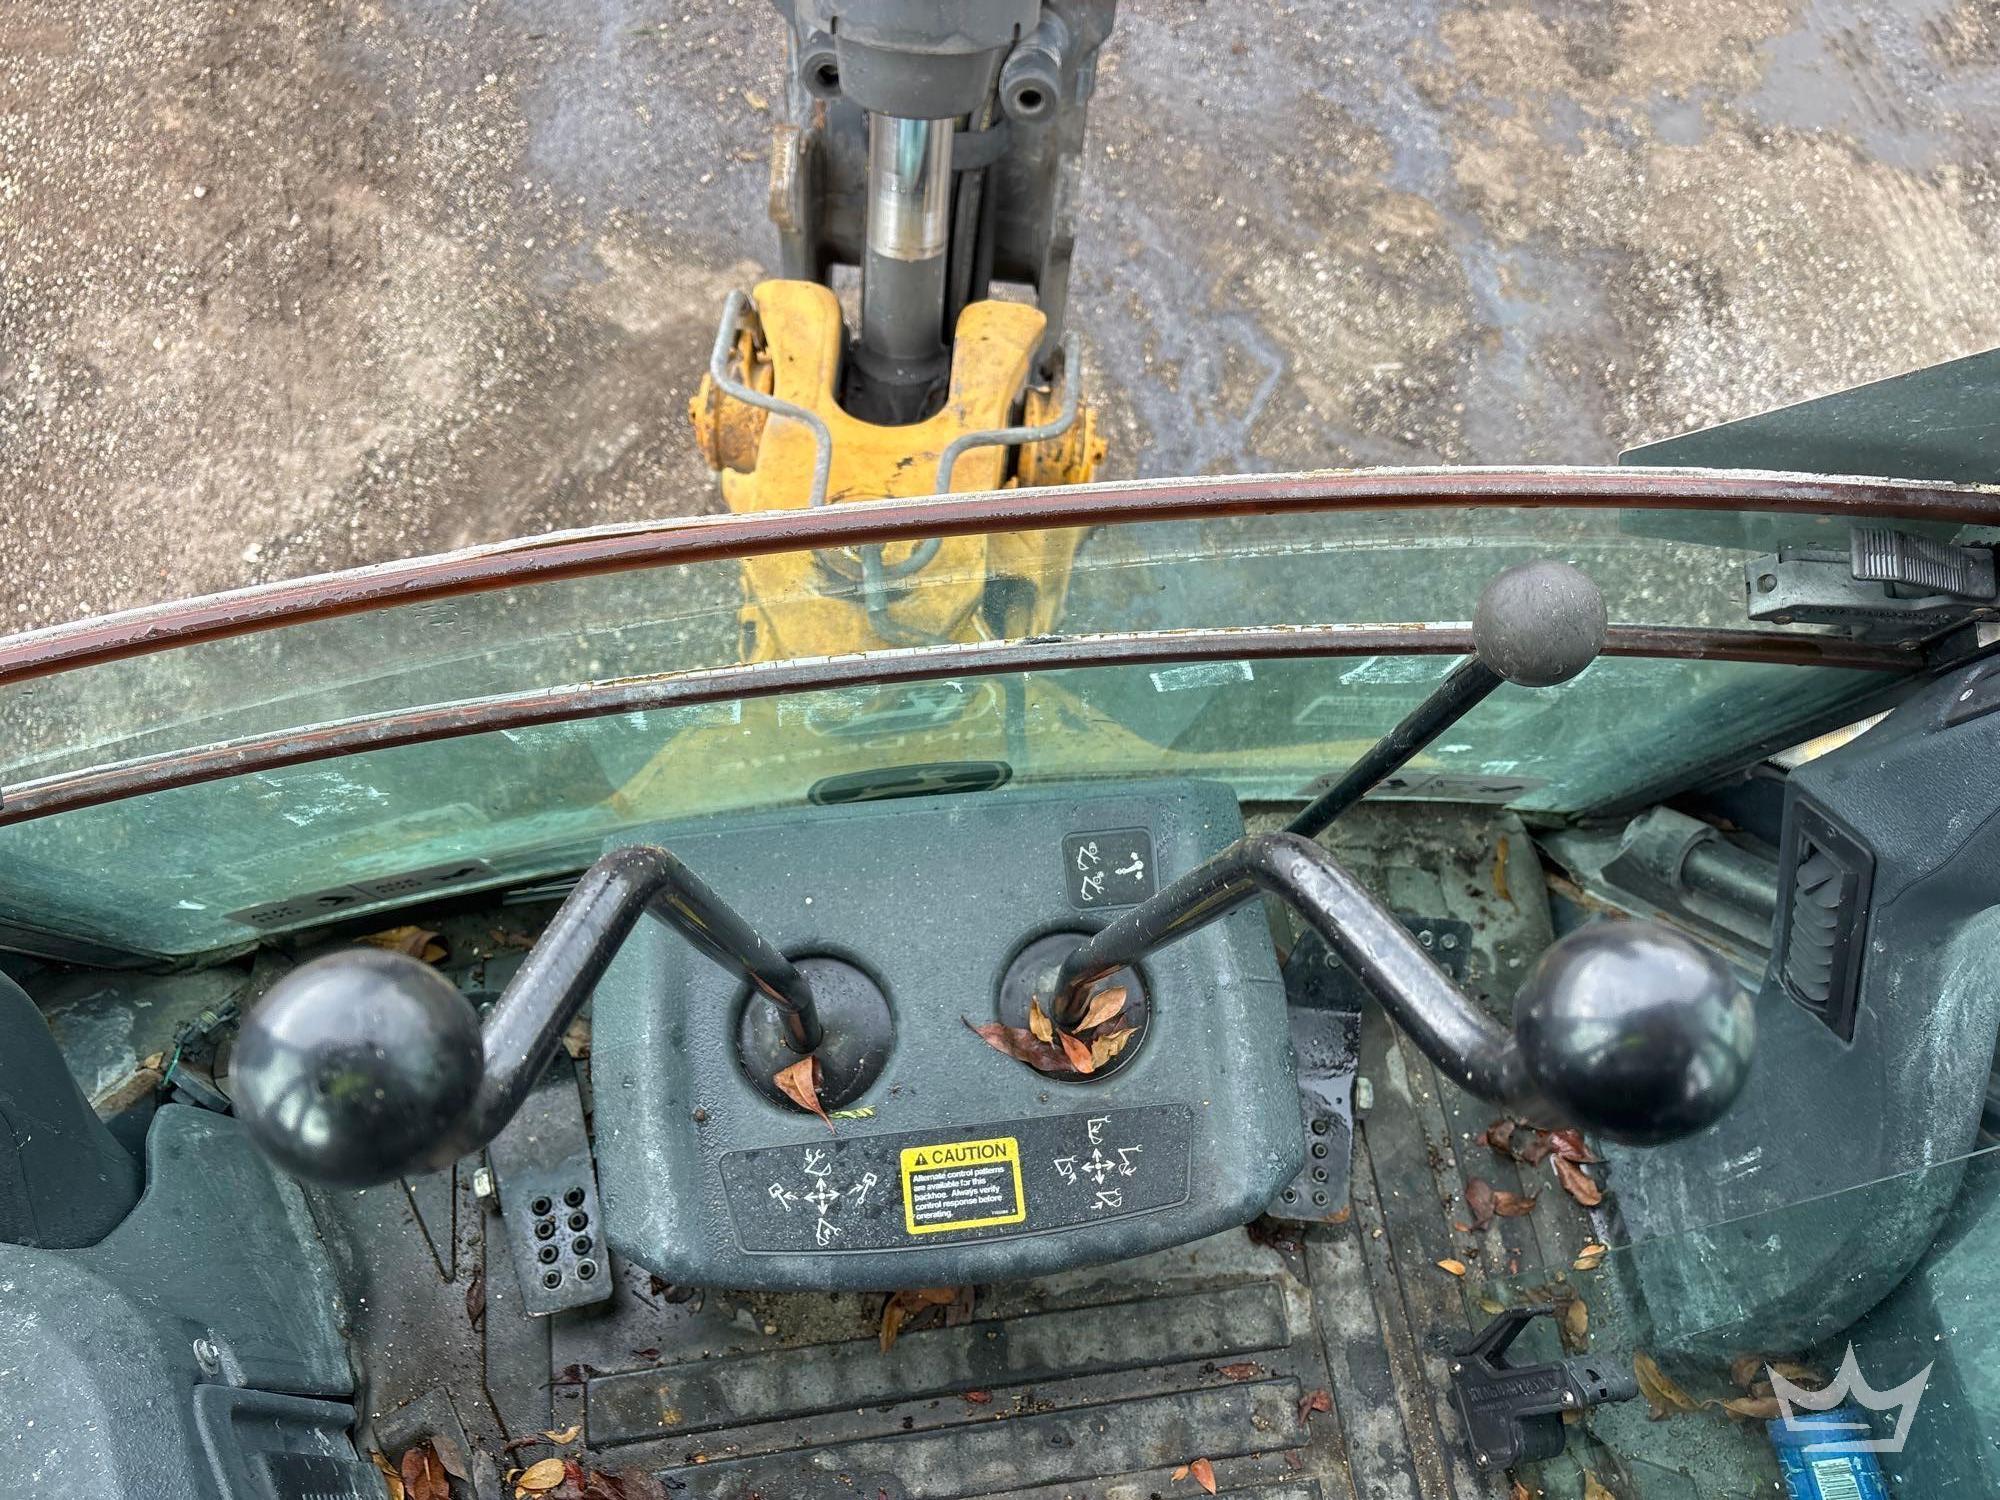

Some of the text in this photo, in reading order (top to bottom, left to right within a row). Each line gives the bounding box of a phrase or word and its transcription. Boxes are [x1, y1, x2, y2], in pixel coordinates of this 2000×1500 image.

[932, 1143, 1007, 1164] CAUTION
[913, 1167, 1004, 1182] Alternate control patterns
[927, 1180, 959, 1191] available
[960, 1177, 970, 1186] for
[971, 1177, 987, 1186] this
[951, 1187, 979, 1197] Always
[979, 1184, 1000, 1194] verify
[915, 1195, 1002, 1210] control response before
